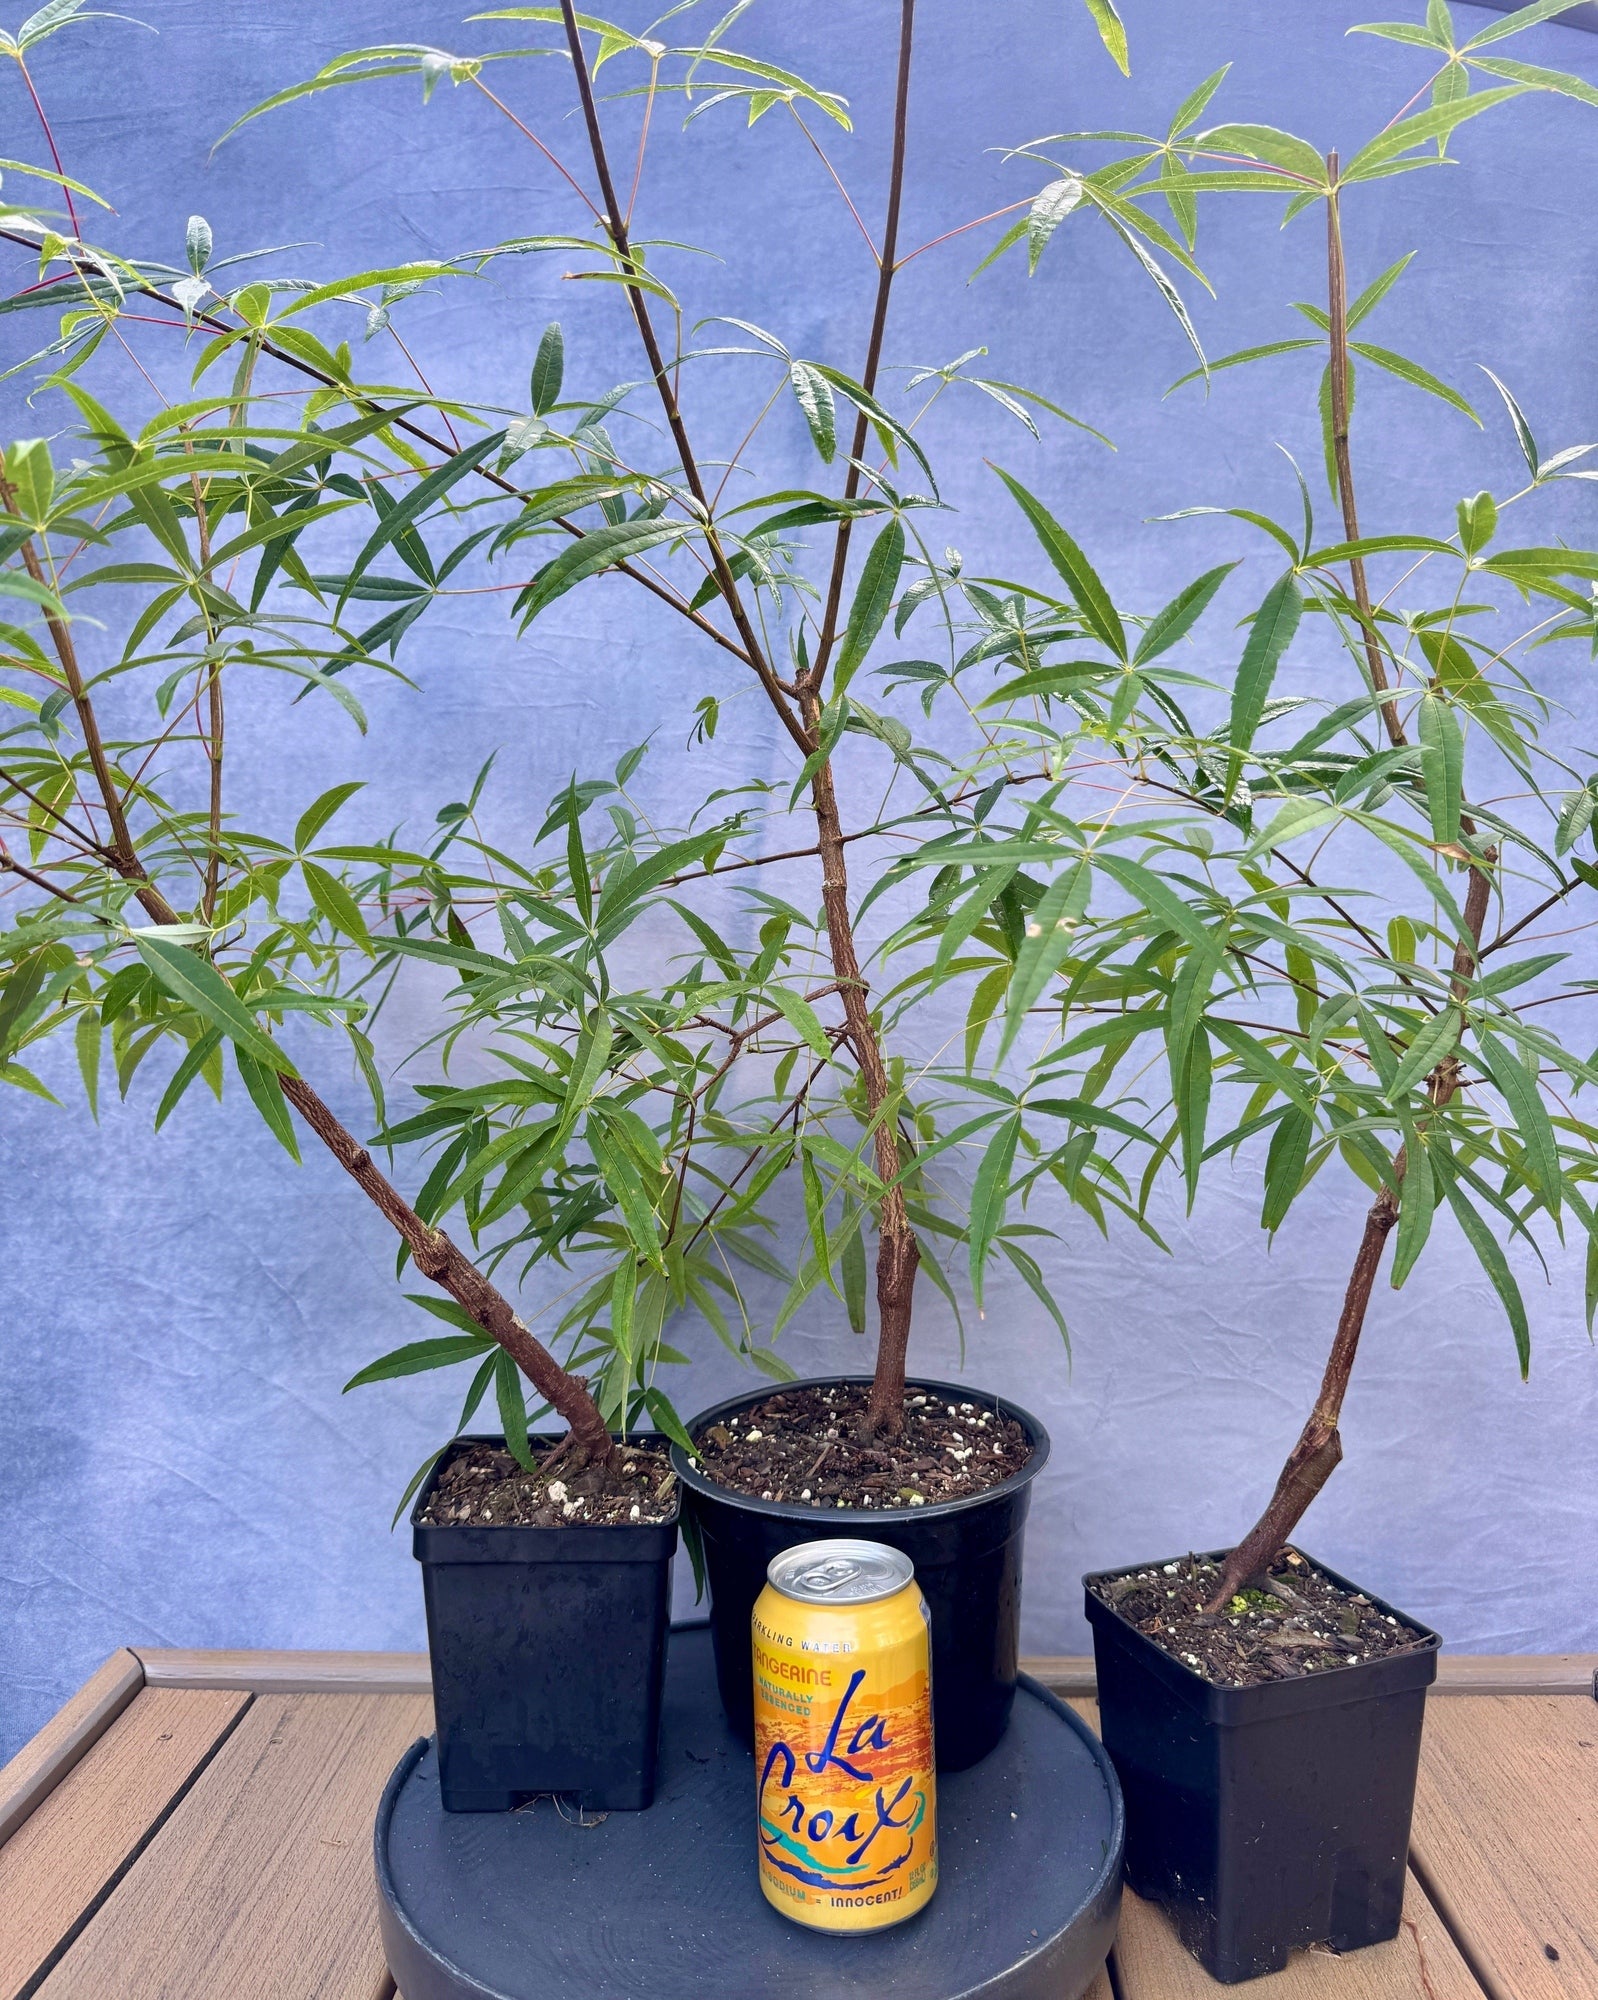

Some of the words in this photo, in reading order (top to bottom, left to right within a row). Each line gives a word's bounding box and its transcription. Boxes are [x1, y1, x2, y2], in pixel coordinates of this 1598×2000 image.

[801, 1640, 851, 1653] WATER
[752, 1641, 832, 1687] TANGERINE
[758, 1675, 814, 1704] NATURALLY
[760, 1688, 812, 1717] ESSENCED
[805, 1669, 893, 1782] La
[758, 1741, 919, 1865] Croix
[831, 1886, 903, 1908] INNOCENT!
